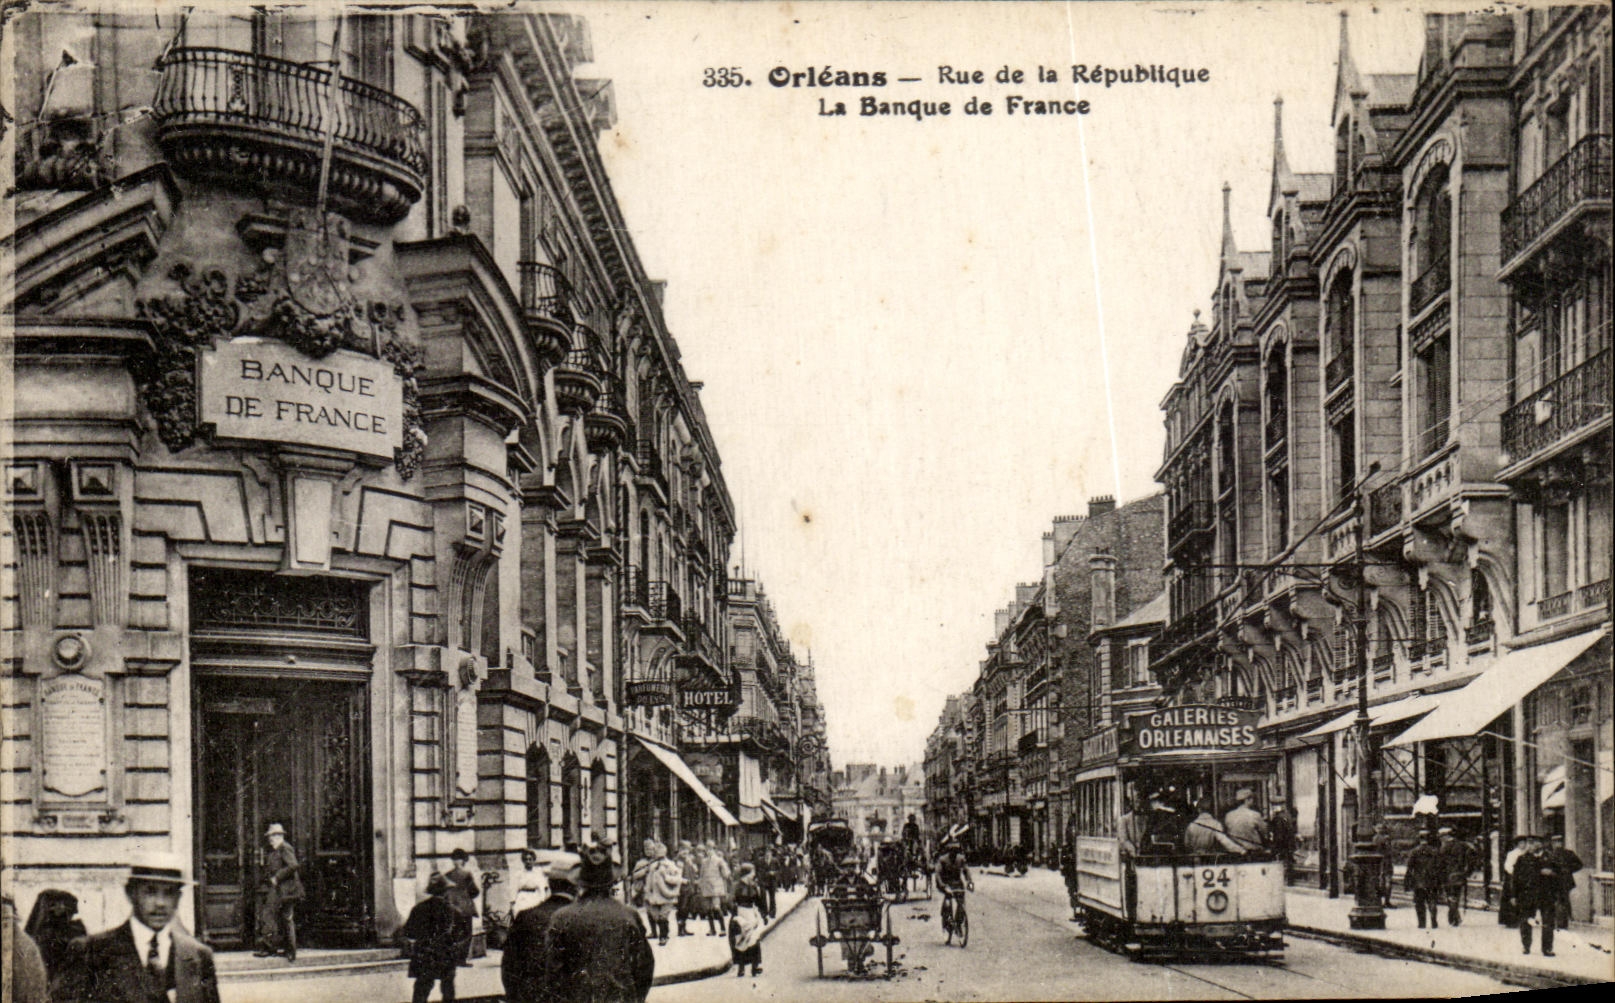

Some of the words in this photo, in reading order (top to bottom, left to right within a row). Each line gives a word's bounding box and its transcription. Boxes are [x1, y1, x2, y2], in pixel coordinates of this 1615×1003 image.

[240, 359, 375, 397] BANQUE
[225, 396, 263, 418] DE
[275, 400, 387, 435] FRANCE
[1150, 708, 1239, 727] GALERIES
[1202, 868, 1231, 888] 24
